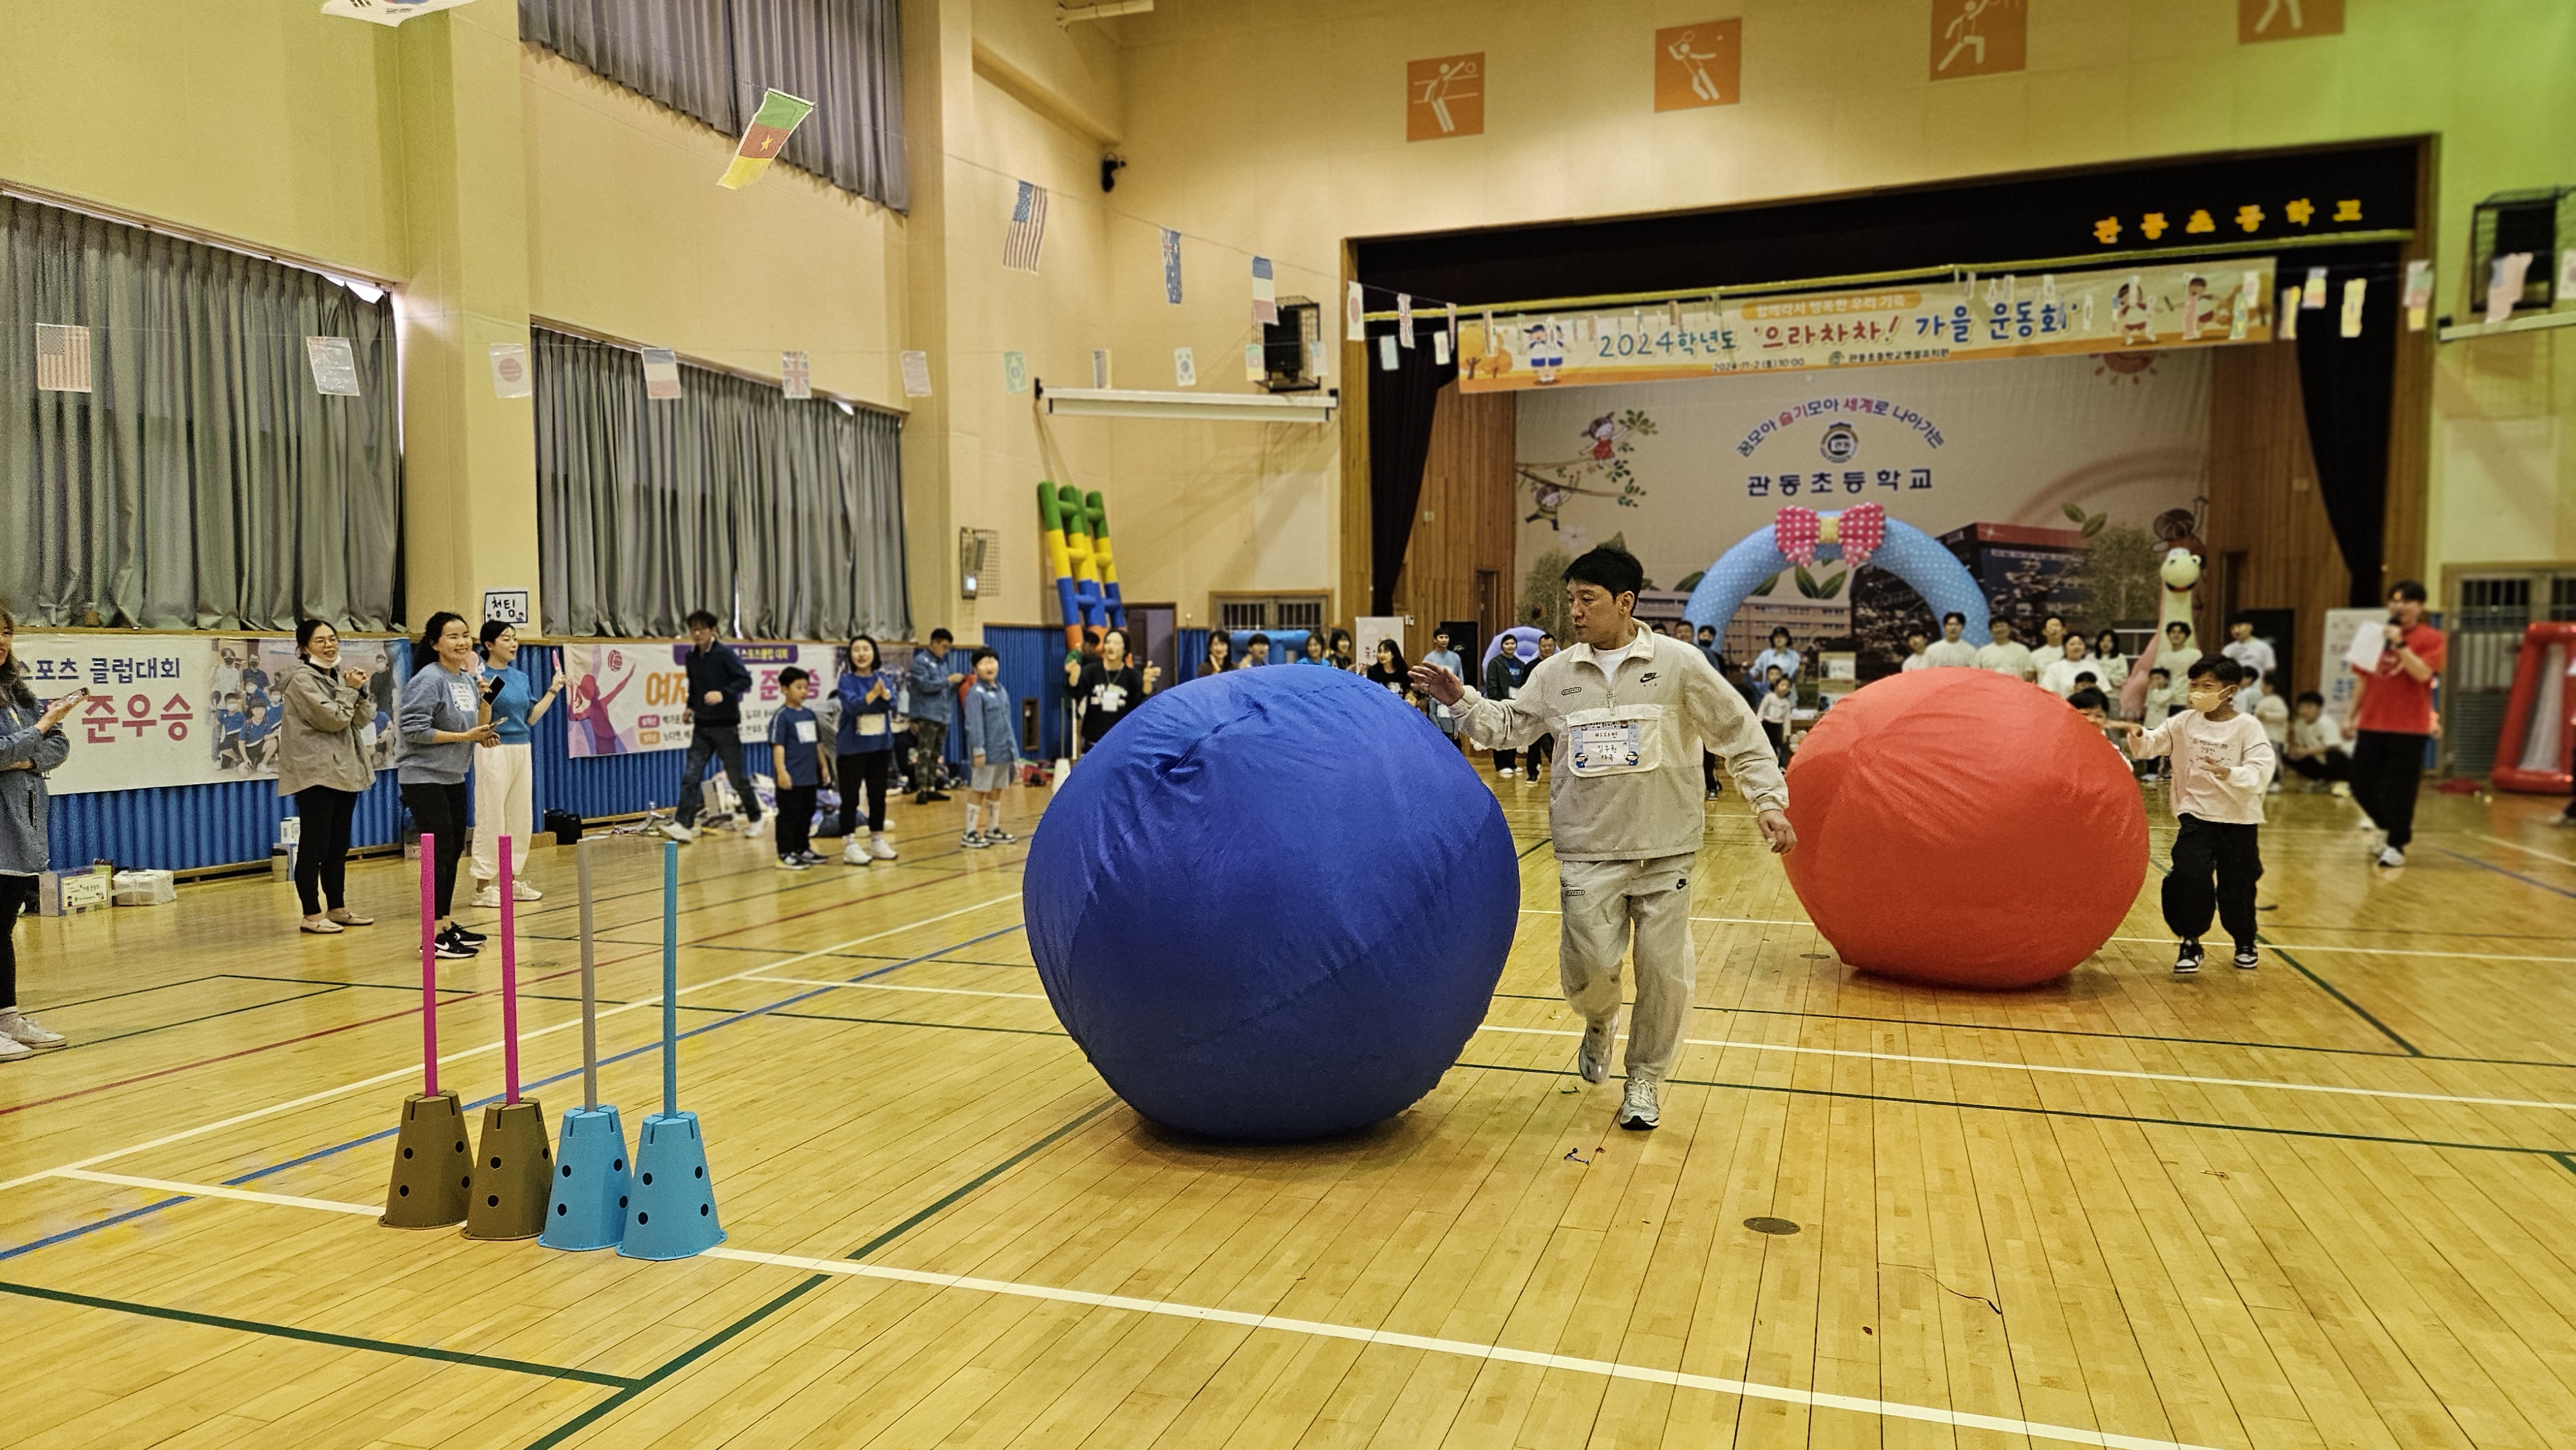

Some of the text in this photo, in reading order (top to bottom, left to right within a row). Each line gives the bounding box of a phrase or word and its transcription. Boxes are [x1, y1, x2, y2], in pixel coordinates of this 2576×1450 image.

[1809, 299, 1847, 314] 행복한
[1850, 296, 1876, 310] 우리
[1880, 294, 1906, 308] 가족
[1598, 329, 1737, 357] 2024학년도
[1915, 305, 1971, 343] 가을
[1737, 397, 1945, 458] 꿈모아 슬기모아 세계로 나아가는
[1747, 468, 1933, 497] 관동초등학교
[491, 596, 516, 618] 청팀
[90, 657, 180, 684] 클럽대회
[82, 693, 193, 744] 준우승
